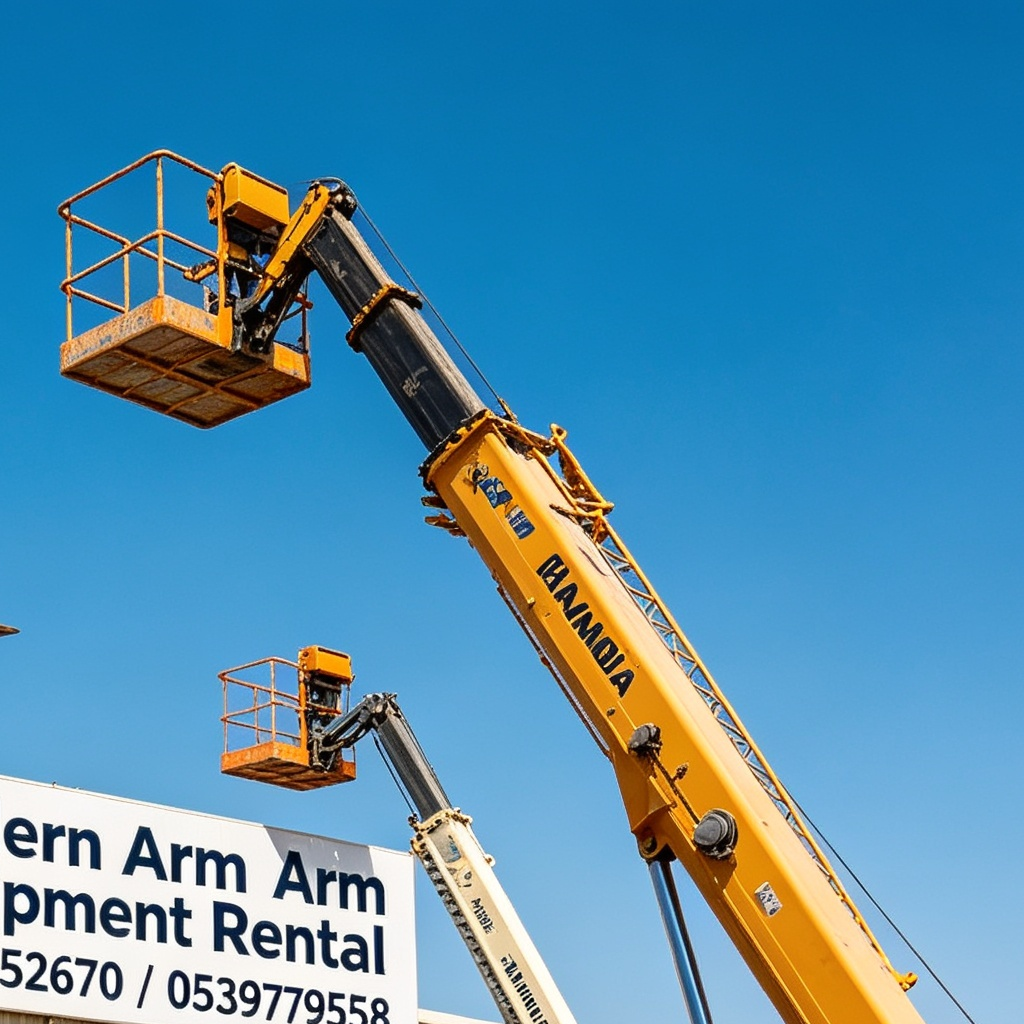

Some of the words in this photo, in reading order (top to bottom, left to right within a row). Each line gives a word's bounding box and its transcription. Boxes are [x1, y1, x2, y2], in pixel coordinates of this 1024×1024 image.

[122, 826, 247, 894] Arm
[273, 850, 387, 916] Arm
[212, 900, 387, 976] Rental
[136, 964, 154, 1009] /
